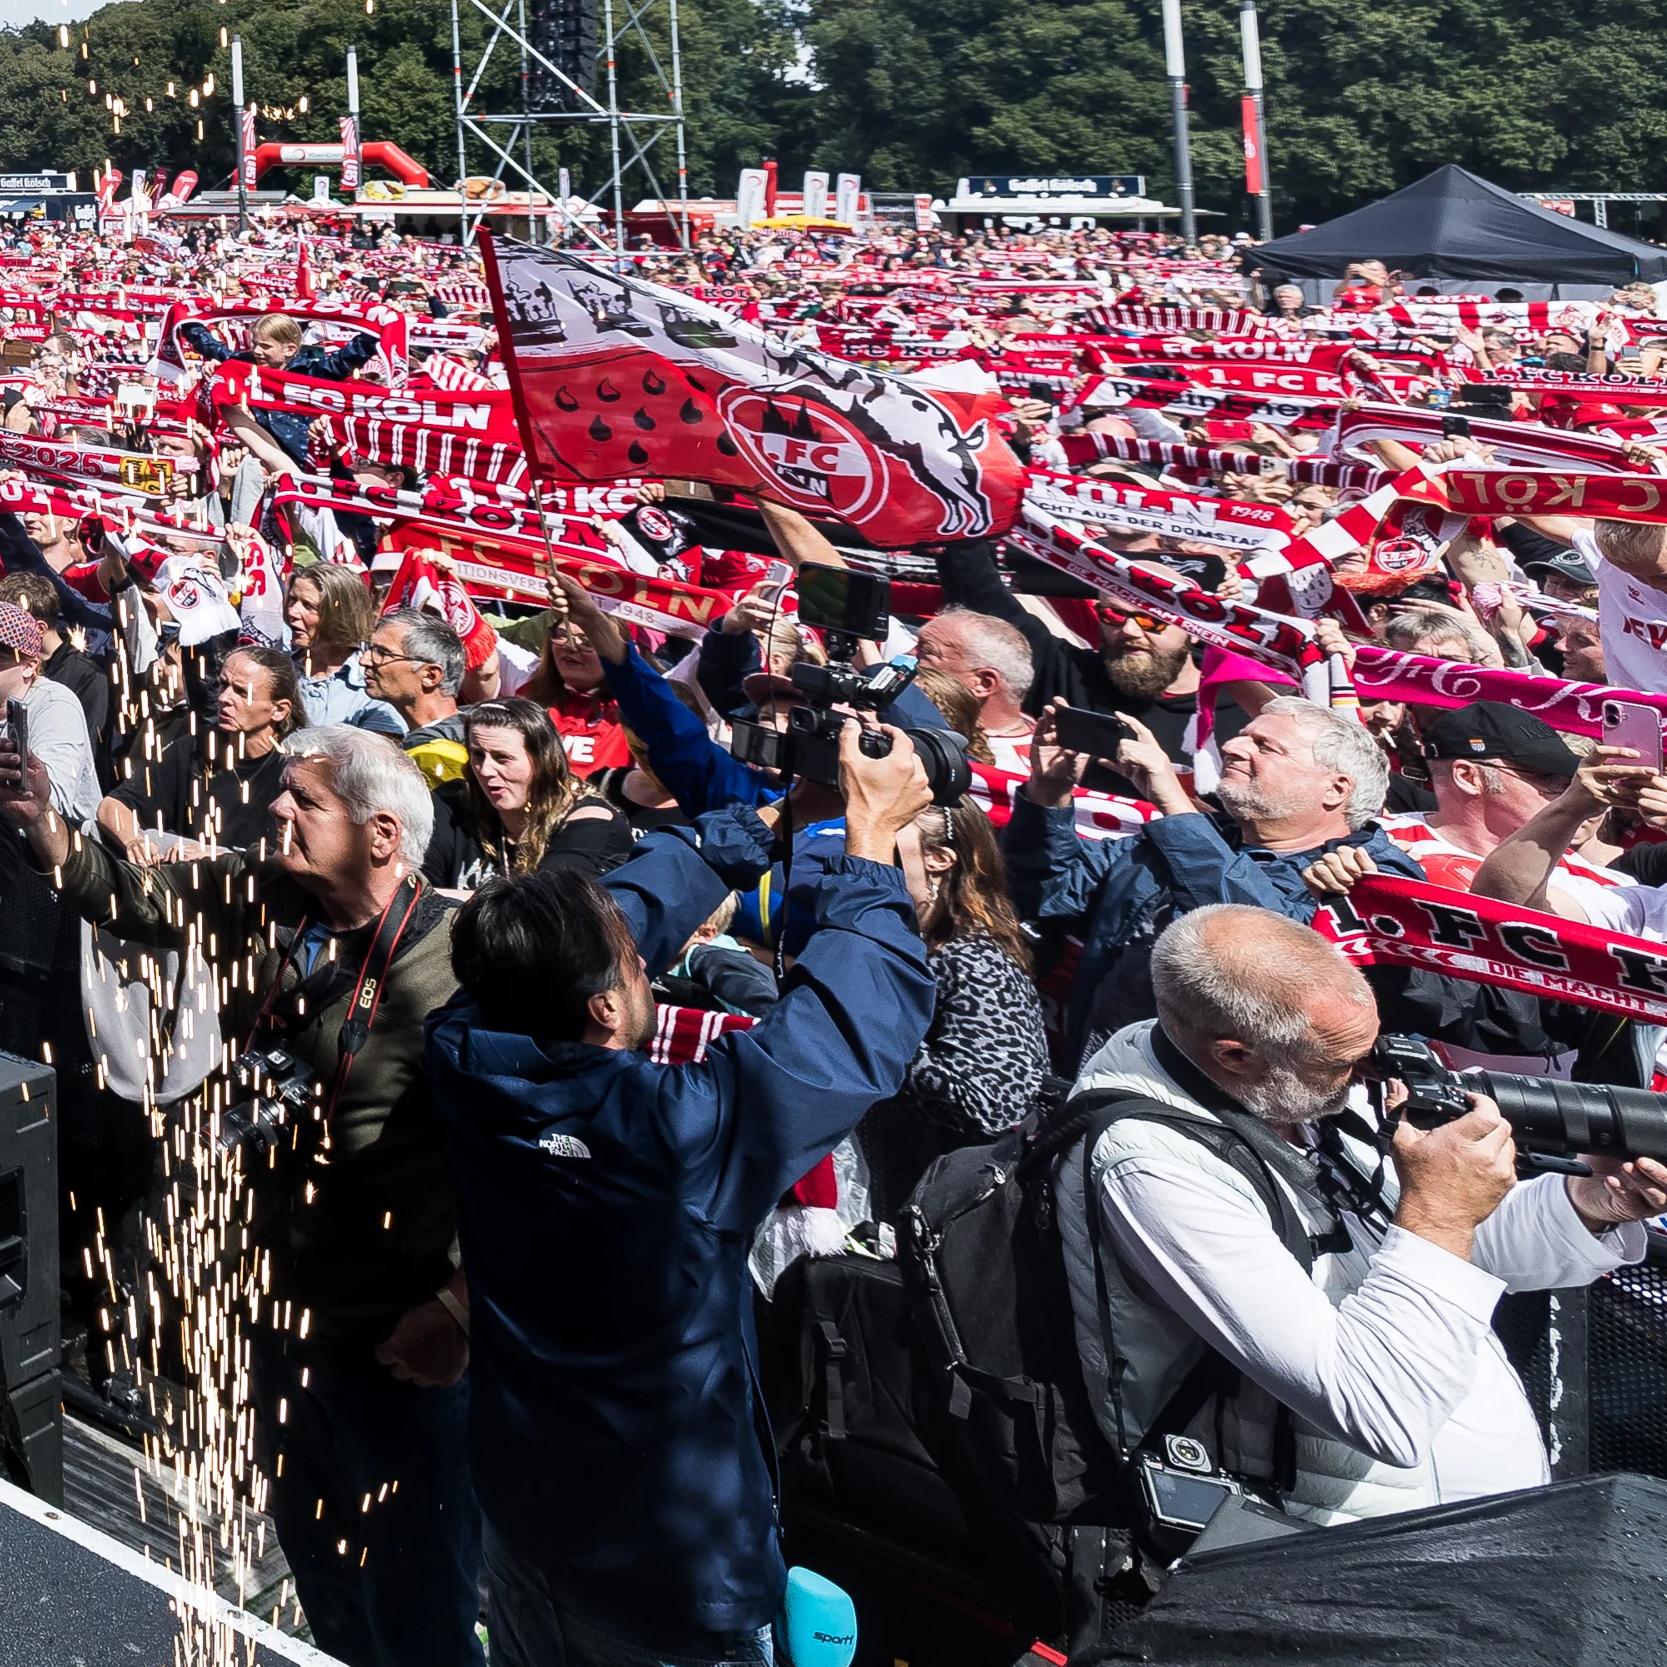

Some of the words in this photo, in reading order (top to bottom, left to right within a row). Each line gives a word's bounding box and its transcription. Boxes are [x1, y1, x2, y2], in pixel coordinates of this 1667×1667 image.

[1162, 342, 1209, 360] FC
[1208, 368, 1242, 385] 1.
[1252, 371, 1306, 391] FC
[283, 382, 346, 413] FC
[352, 389, 492, 430] KÖLN
[1112, 380, 1339, 428] RheinEnerg
[1028, 473, 1221, 529] KÖLN
[1230, 504, 1275, 522] 1948
[1039, 502, 1079, 515] CHT
[1082, 508, 1120, 521] AUS
[1127, 516, 1164, 531] DER
[1148, 605, 1179, 623] AM
[1181, 618, 1230, 648] RHEIN
[1318, 892, 1405, 939] 1.
[1411, 898, 1571, 973] FC
[359, 978, 377, 1010] EOS
[1487, 959, 1530, 981] DIE
[1540, 971, 1651, 1012] MACHT
[539, 1139, 571, 1151] NORTH
[549, 1147, 574, 1158] FACE
[551, 1134, 571, 1144] THE
